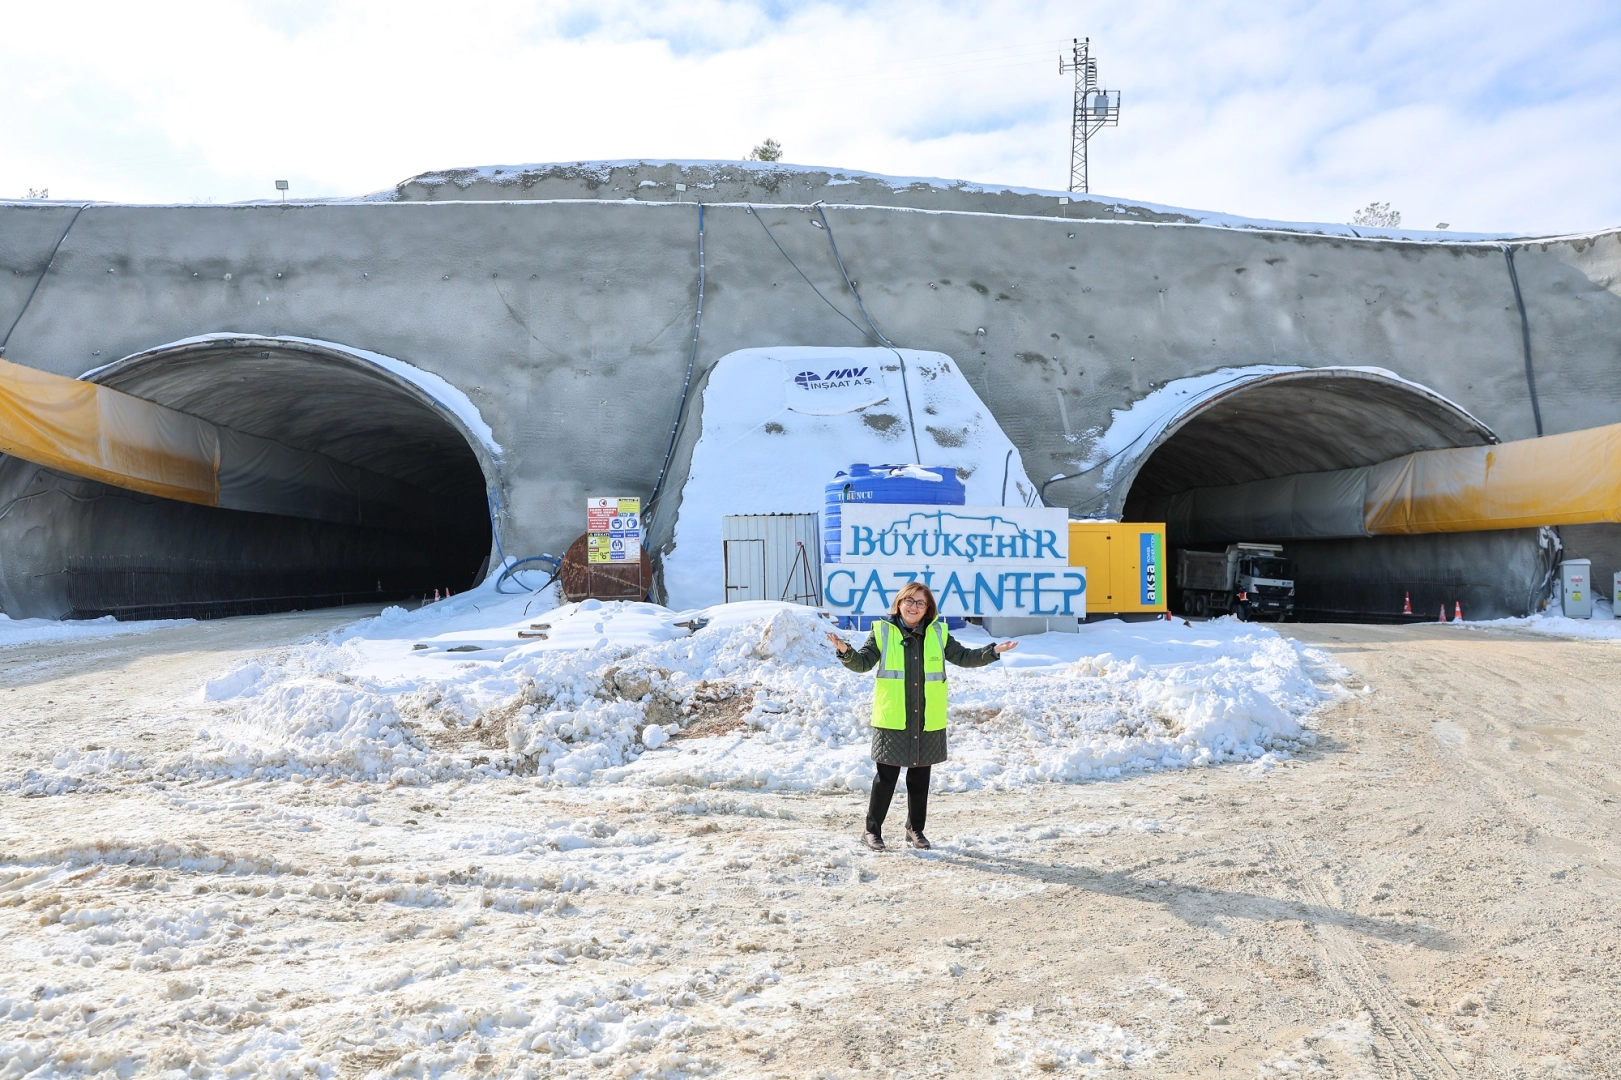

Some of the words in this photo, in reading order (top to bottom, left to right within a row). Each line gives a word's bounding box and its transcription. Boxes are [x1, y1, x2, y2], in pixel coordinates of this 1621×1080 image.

[810, 380, 851, 390] İNŞAAT
[854, 377, 875, 386] A.Ş.
[846, 526, 1066, 562] BÜYÜKŞEHİR
[1147, 564, 1156, 601] aksa
